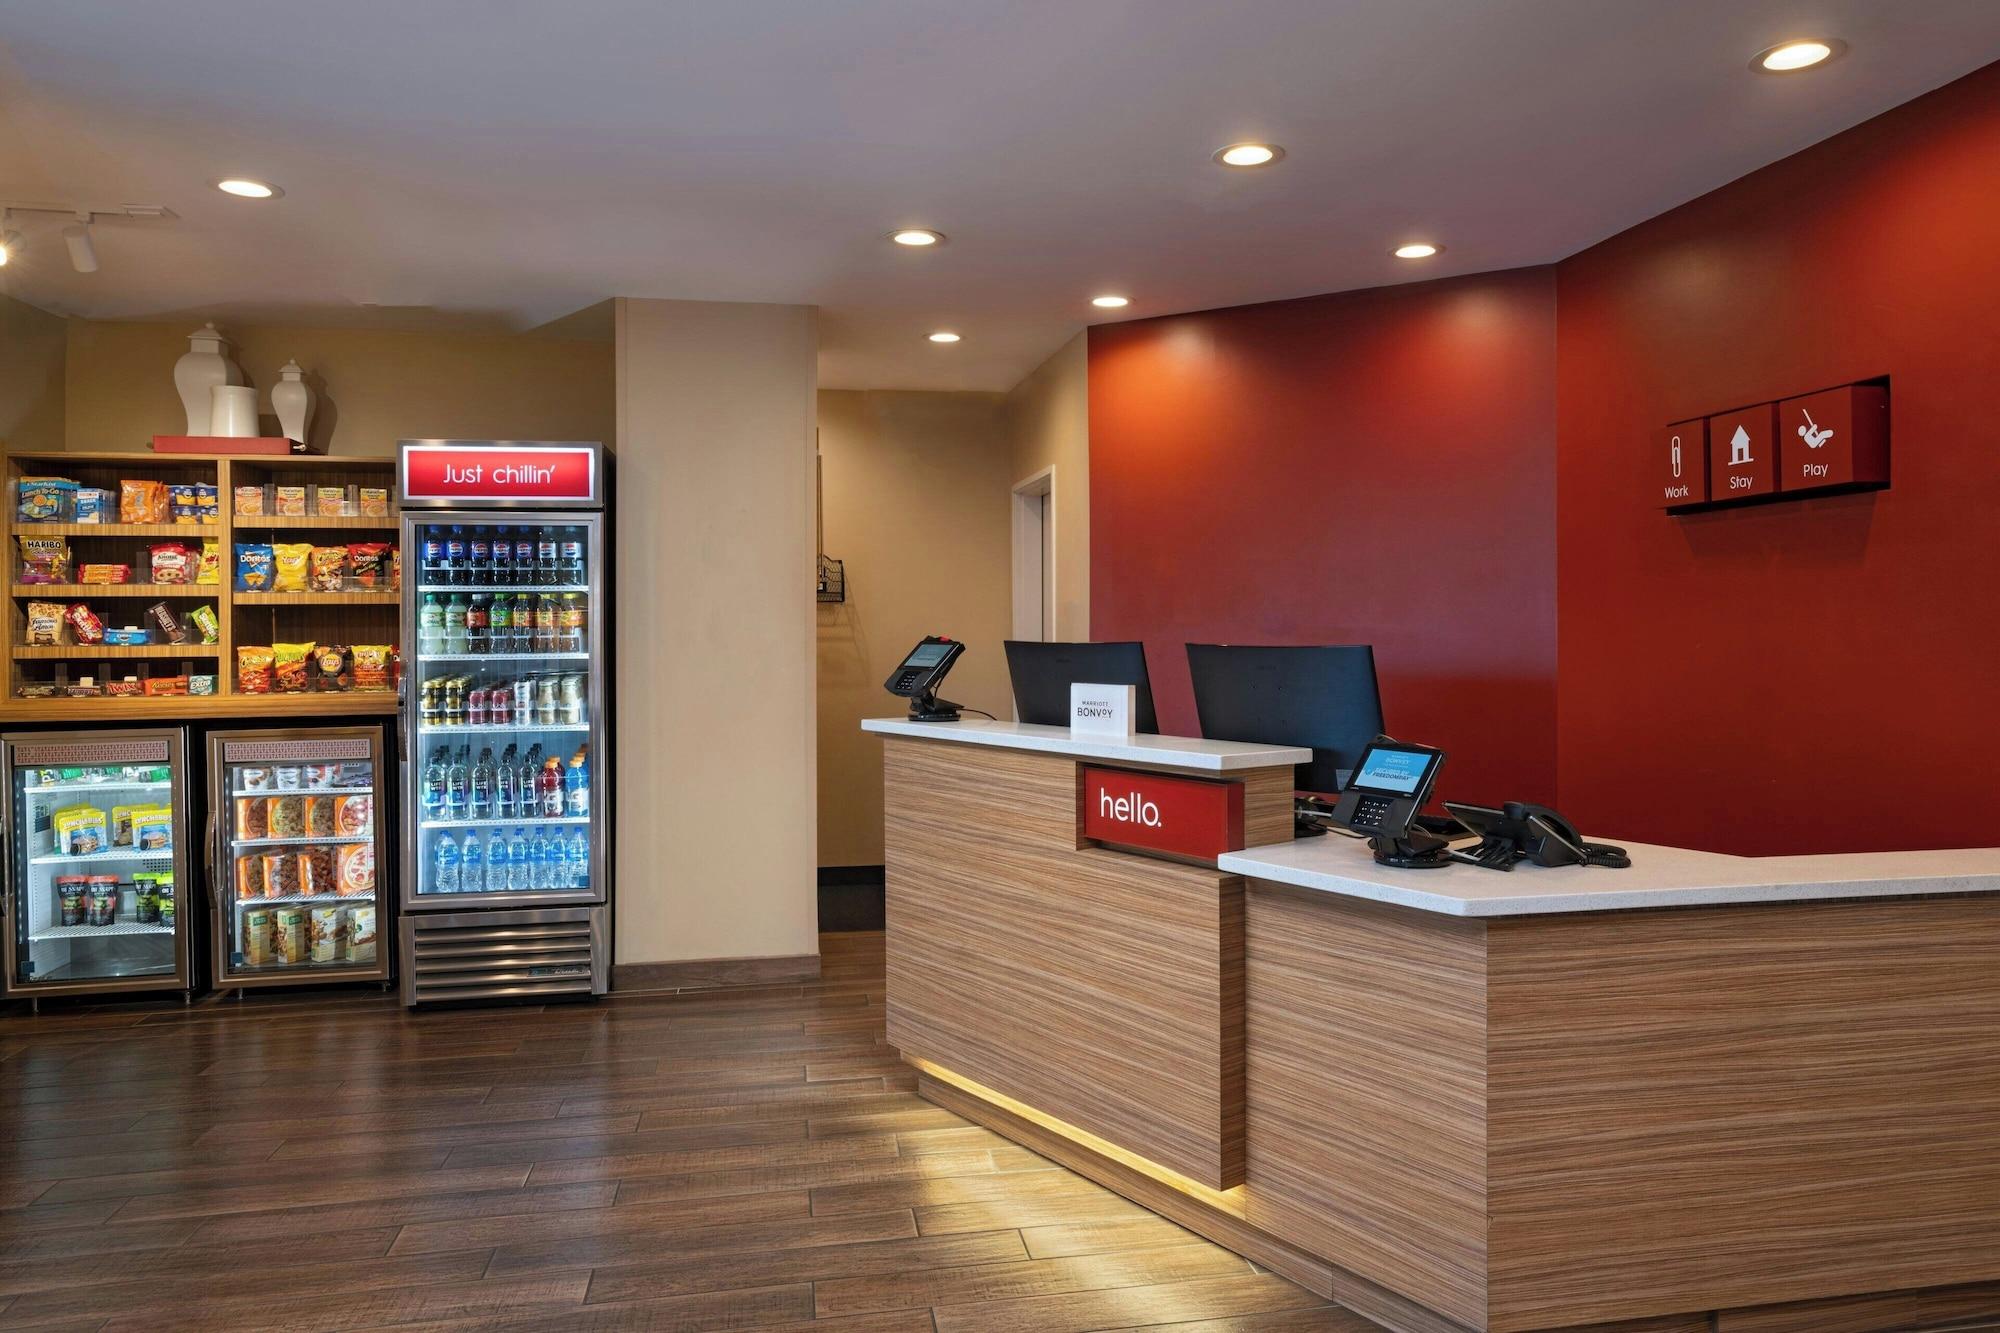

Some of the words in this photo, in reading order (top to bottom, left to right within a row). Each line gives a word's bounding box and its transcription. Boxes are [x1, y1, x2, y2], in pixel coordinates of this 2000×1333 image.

[443, 463, 483, 484] Just
[1803, 463, 1828, 477] Play
[1730, 476, 1752, 490] Stay
[22, 489, 41, 498] Lunch
[1664, 485, 1688, 498] Work
[27, 540, 61, 549] HARIBO
[240, 554, 271, 563] Doritos
[1077, 707, 1113, 718] BONVOY
[1100, 787, 1162, 827] hello.
